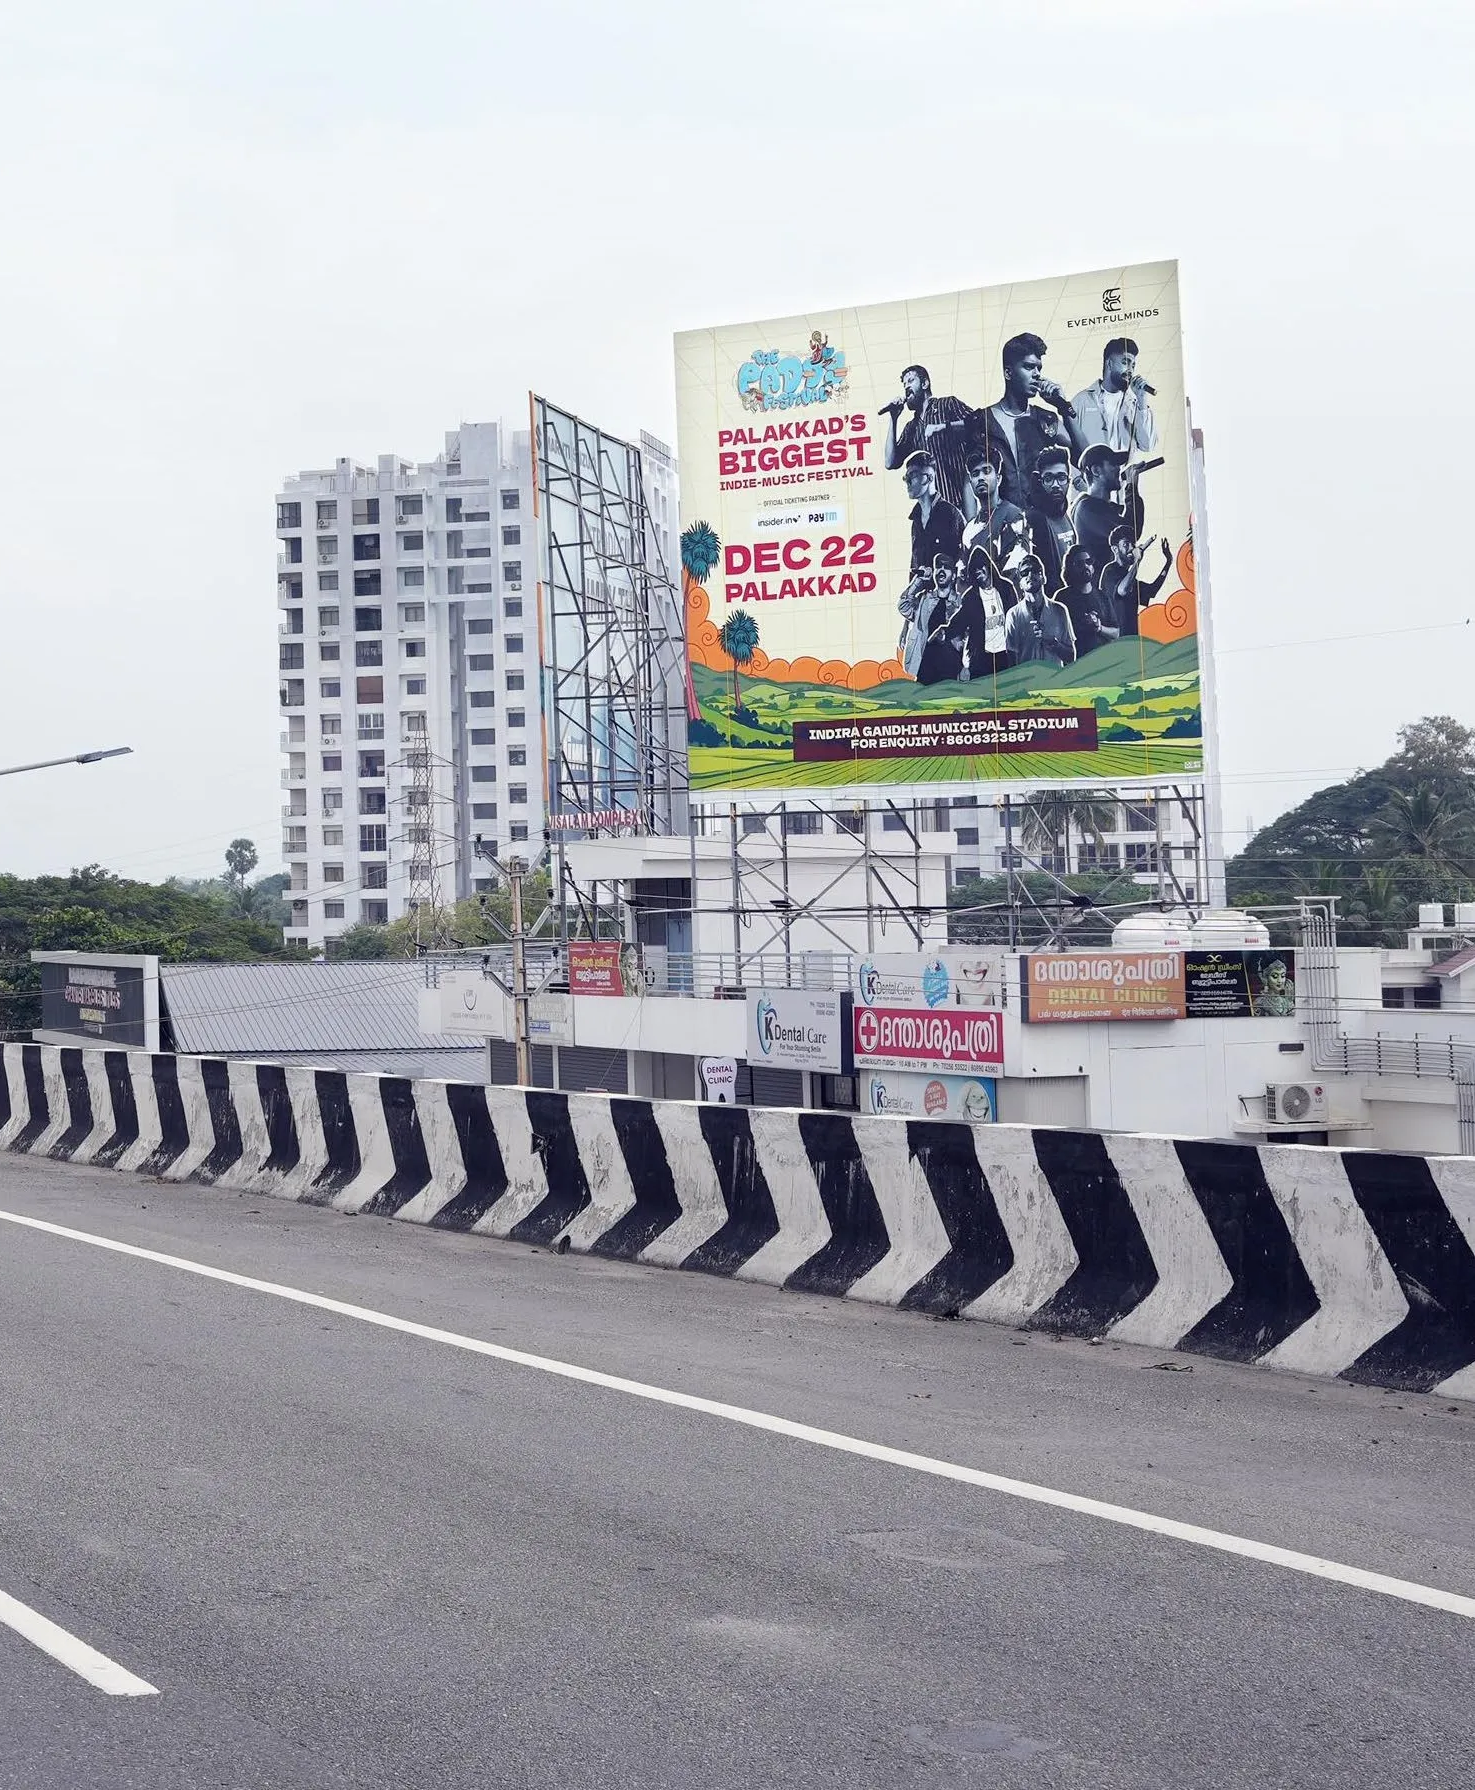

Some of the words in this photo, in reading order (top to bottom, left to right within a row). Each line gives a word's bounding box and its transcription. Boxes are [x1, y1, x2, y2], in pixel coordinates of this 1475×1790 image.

[1067, 309, 1159, 328] EVENTFULMINDS
[763, 387, 828, 411] FESTIVAL
[719, 436, 871, 476] BIGGEST
[720, 473, 805, 491] INDIE-MUSIC
[807, 466, 873, 482] FESTIVAL
[763, 499, 783, 507] OFFICIAL
[784, 496, 808, 505] TICKETING
[809, 494, 830, 502] PARTNER
[757, 516, 793, 527] insider.in
[725, 538, 812, 576] DEC
[820, 532, 875, 568] 22
[725, 571, 877, 603] PALAKKAD
[809, 726, 861, 740] INDIRA
[863, 723, 919, 737] GANDHI
[920, 719, 1006, 735] MUNICIPAL
[1008, 717, 1078, 732] STADIUM
[850, 738, 877, 750] FOR
[879, 735, 938, 749] ENQUIRY
[549, 813, 589, 830] VISALAM
[591, 808, 639, 827] COMPLEX
[1035, 953, 1180, 986] ദന്താശുപത്രി
[1048, 988, 1108, 1005] DENTAL
[1114, 987, 1168, 1003] CLINIC
[764, 1016, 774, 1041] K
[775, 1024, 805, 1043] Dental
[807, 1028, 827, 1044] Care
[880, 1014, 998, 1060] ദന്താശുപത്രി
[706, 1065, 733, 1074] DENTAL
[708, 1076, 733, 1084] CLINIC
